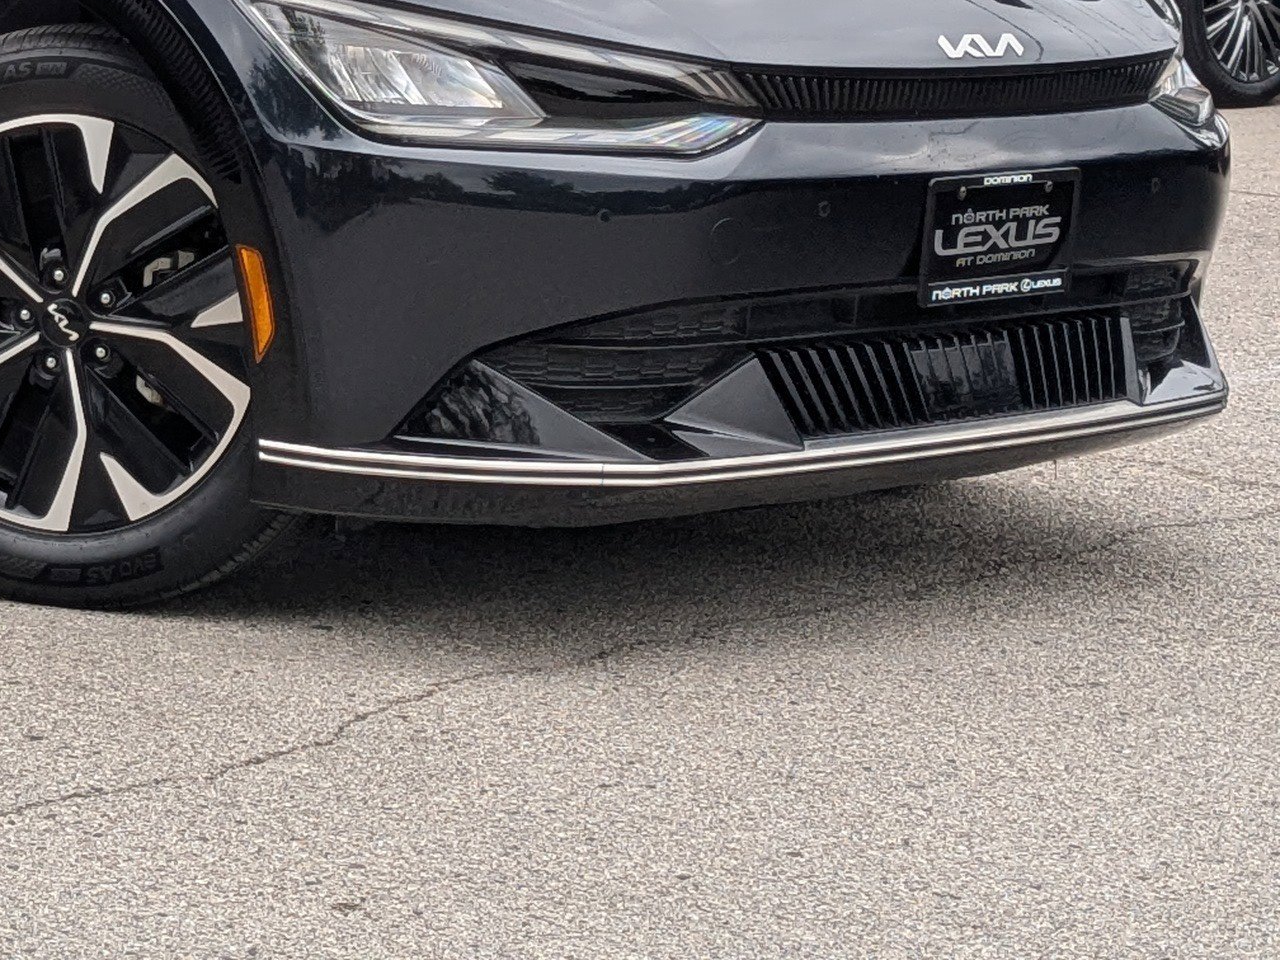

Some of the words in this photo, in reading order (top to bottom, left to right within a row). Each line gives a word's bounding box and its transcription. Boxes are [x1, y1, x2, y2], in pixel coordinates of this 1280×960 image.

[938, 33, 1024, 58] KIA
[984, 174, 1033, 185] DOMINION
[951, 208, 1007, 225] NORTH
[1010, 204, 1050, 218] PARK
[934, 216, 1062, 256] LEXUS
[956, 256, 974, 267] AT
[976, 248, 1035, 264] DOMINION
[932, 286, 980, 300] NORTH
[982, 282, 1018, 295] PARK
[1032, 278, 1062, 288] LEXUS
